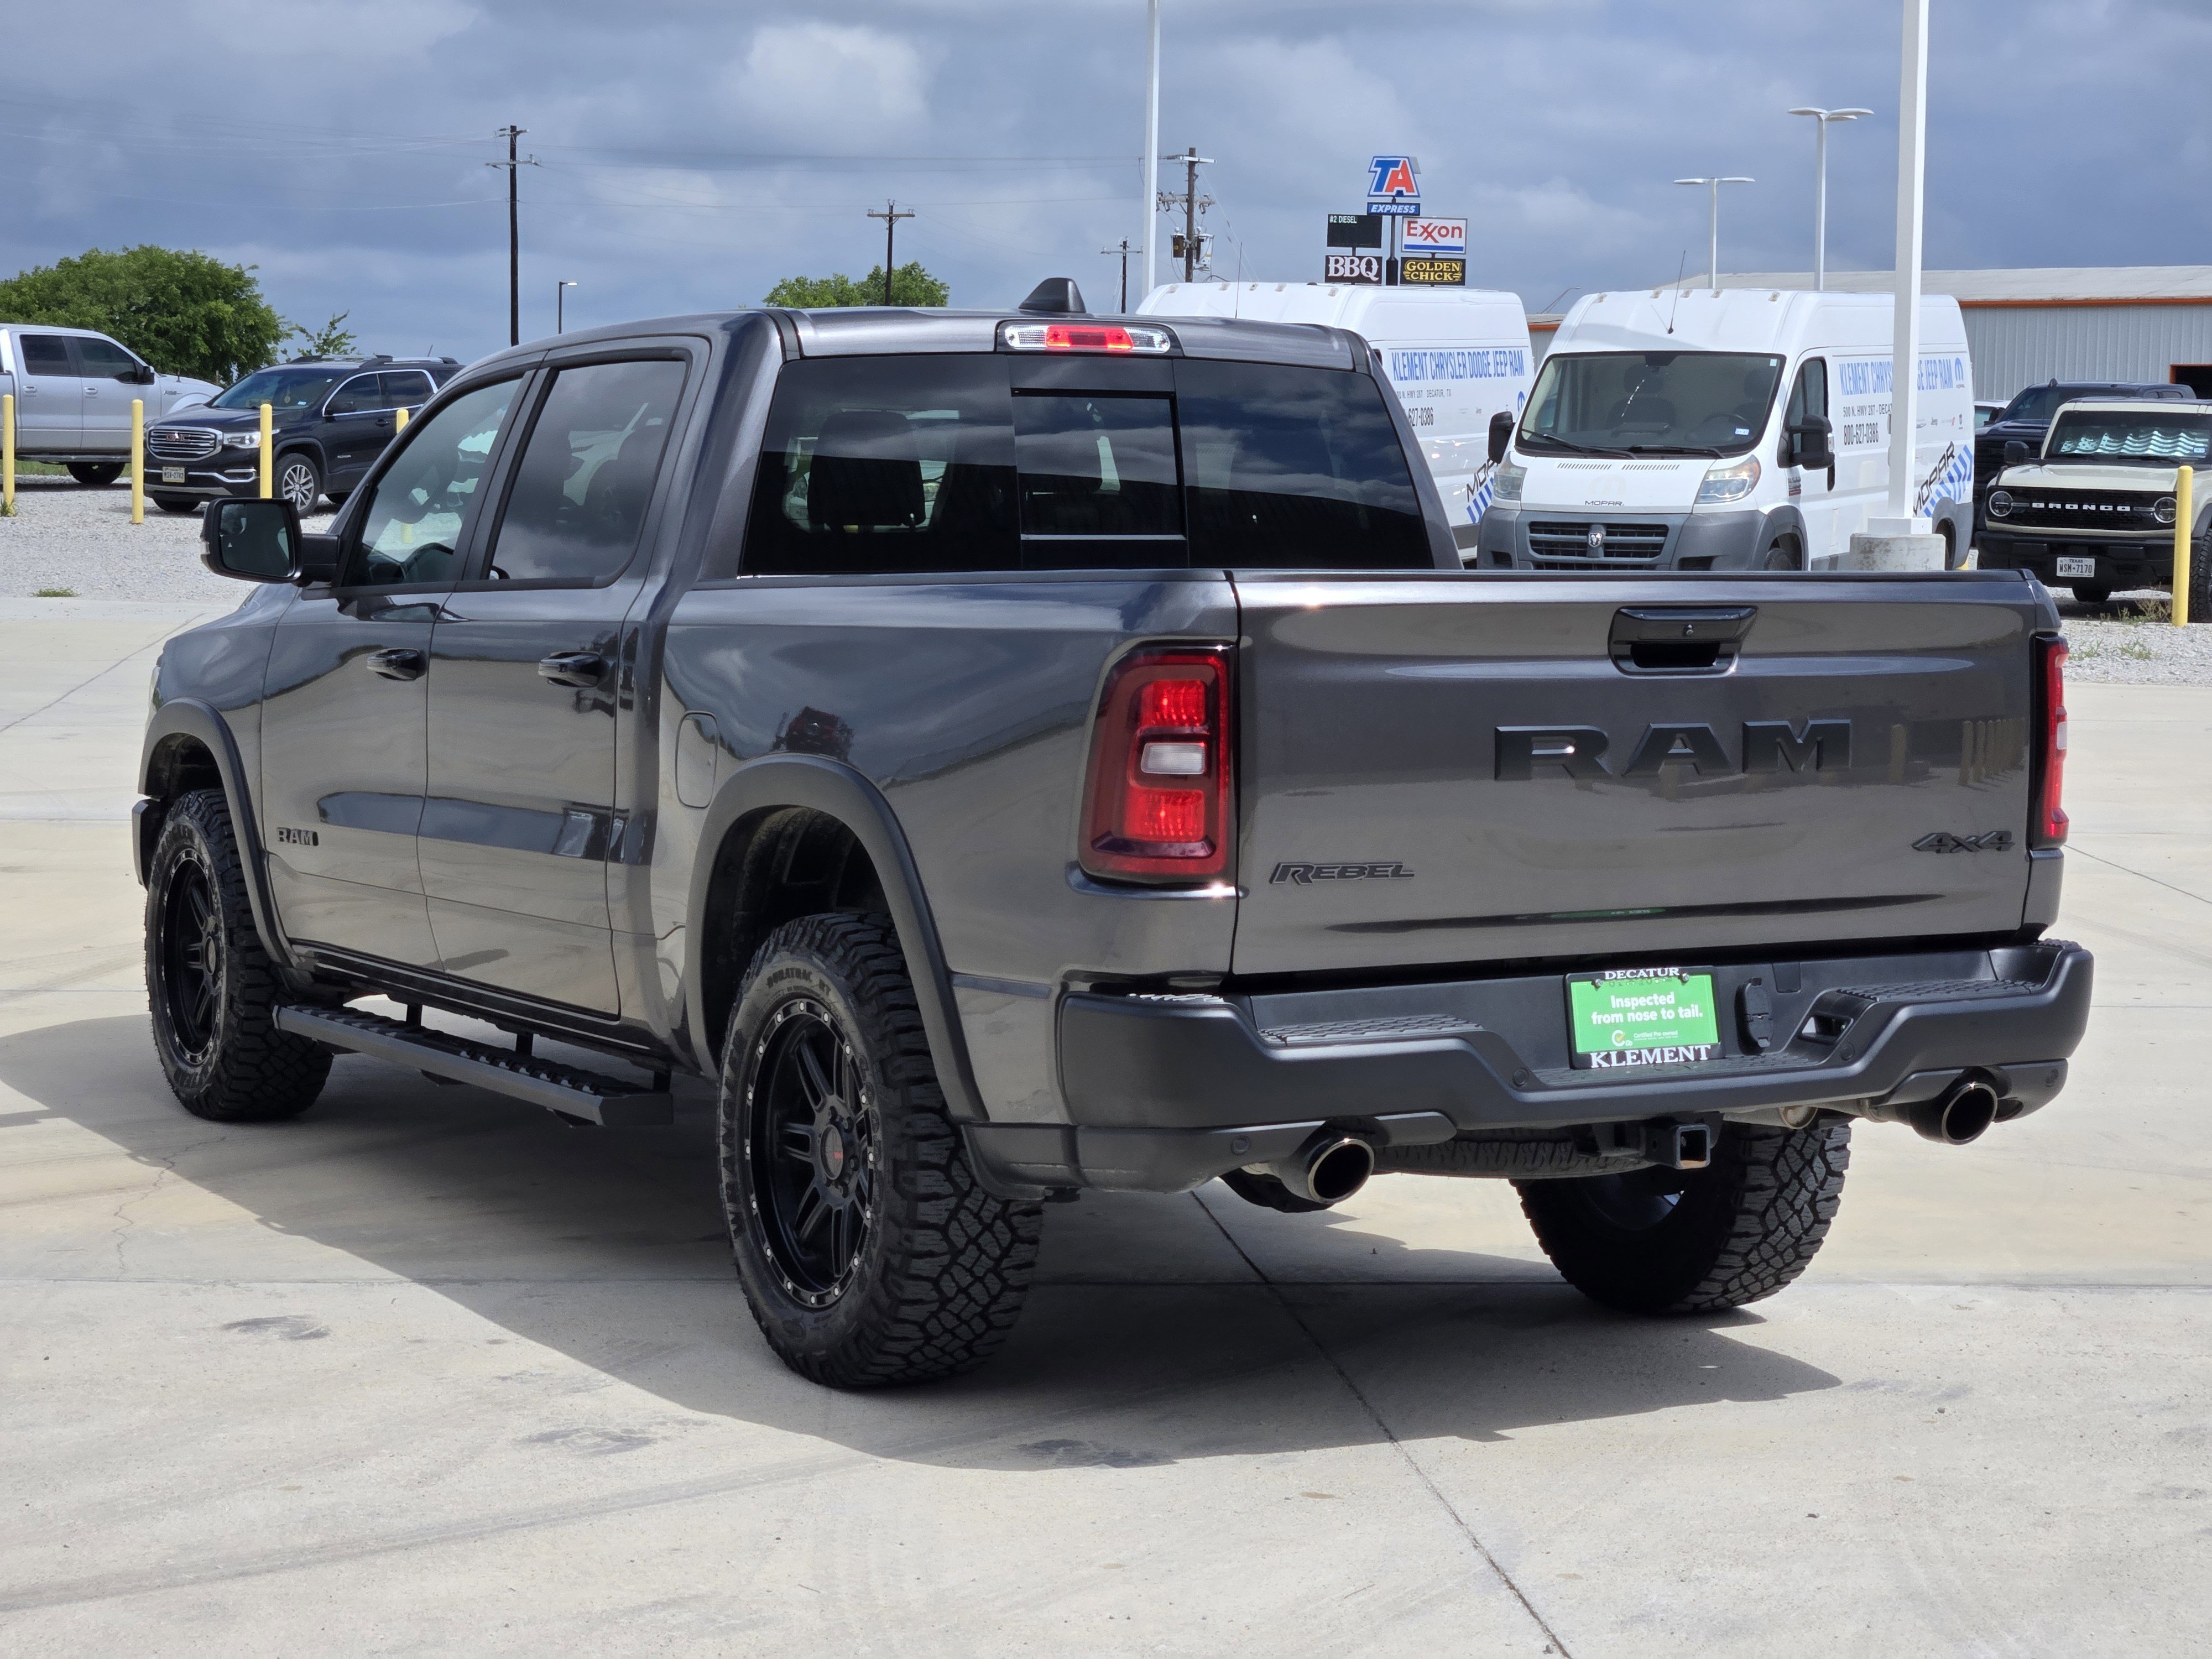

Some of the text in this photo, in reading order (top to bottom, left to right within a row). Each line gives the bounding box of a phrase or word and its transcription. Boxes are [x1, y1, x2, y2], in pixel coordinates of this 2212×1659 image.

[1373, 159, 1415, 192] TA
[1329, 215, 1358, 224] #2 DIESEL
[1370, 205, 1416, 213] EXPRESS
[1406, 220, 1463, 244] Exxon
[1327, 256, 1380, 281] BBQ
[1405, 260, 1462, 272] GOLDEN
[1410, 272, 1454, 281] CHICK
[1391, 349, 1525, 381] KLEMENT CHRYSLER DODGE JEEP RAM
[1924, 359, 1938, 390] JEEP
[1938, 358, 1954, 389] RAM
[1838, 362, 1871, 396] KLEMENT
[1870, 361, 1893, 394] CHRYS
[1407, 389, 1416, 399] HWY
[1408, 406, 1434, 427] 627-0386
[1857, 405, 1867, 417] HWY
[1466, 458, 1499, 503] MOP
[2032, 502, 2131, 512] BRONCO
[1493, 718, 1853, 781] RAM
[276, 827, 319, 847] RAM
[1911, 830, 2015, 854] 4x4
[1269, 861, 1416, 885] REBEL
[1604, 967, 1681, 980] DECATUR
[1610, 991, 1675, 1010] Inspected
[1591, 1004, 1704, 1025] from nose to tail.
[1590, 1045, 1712, 1068] KLEMENT
